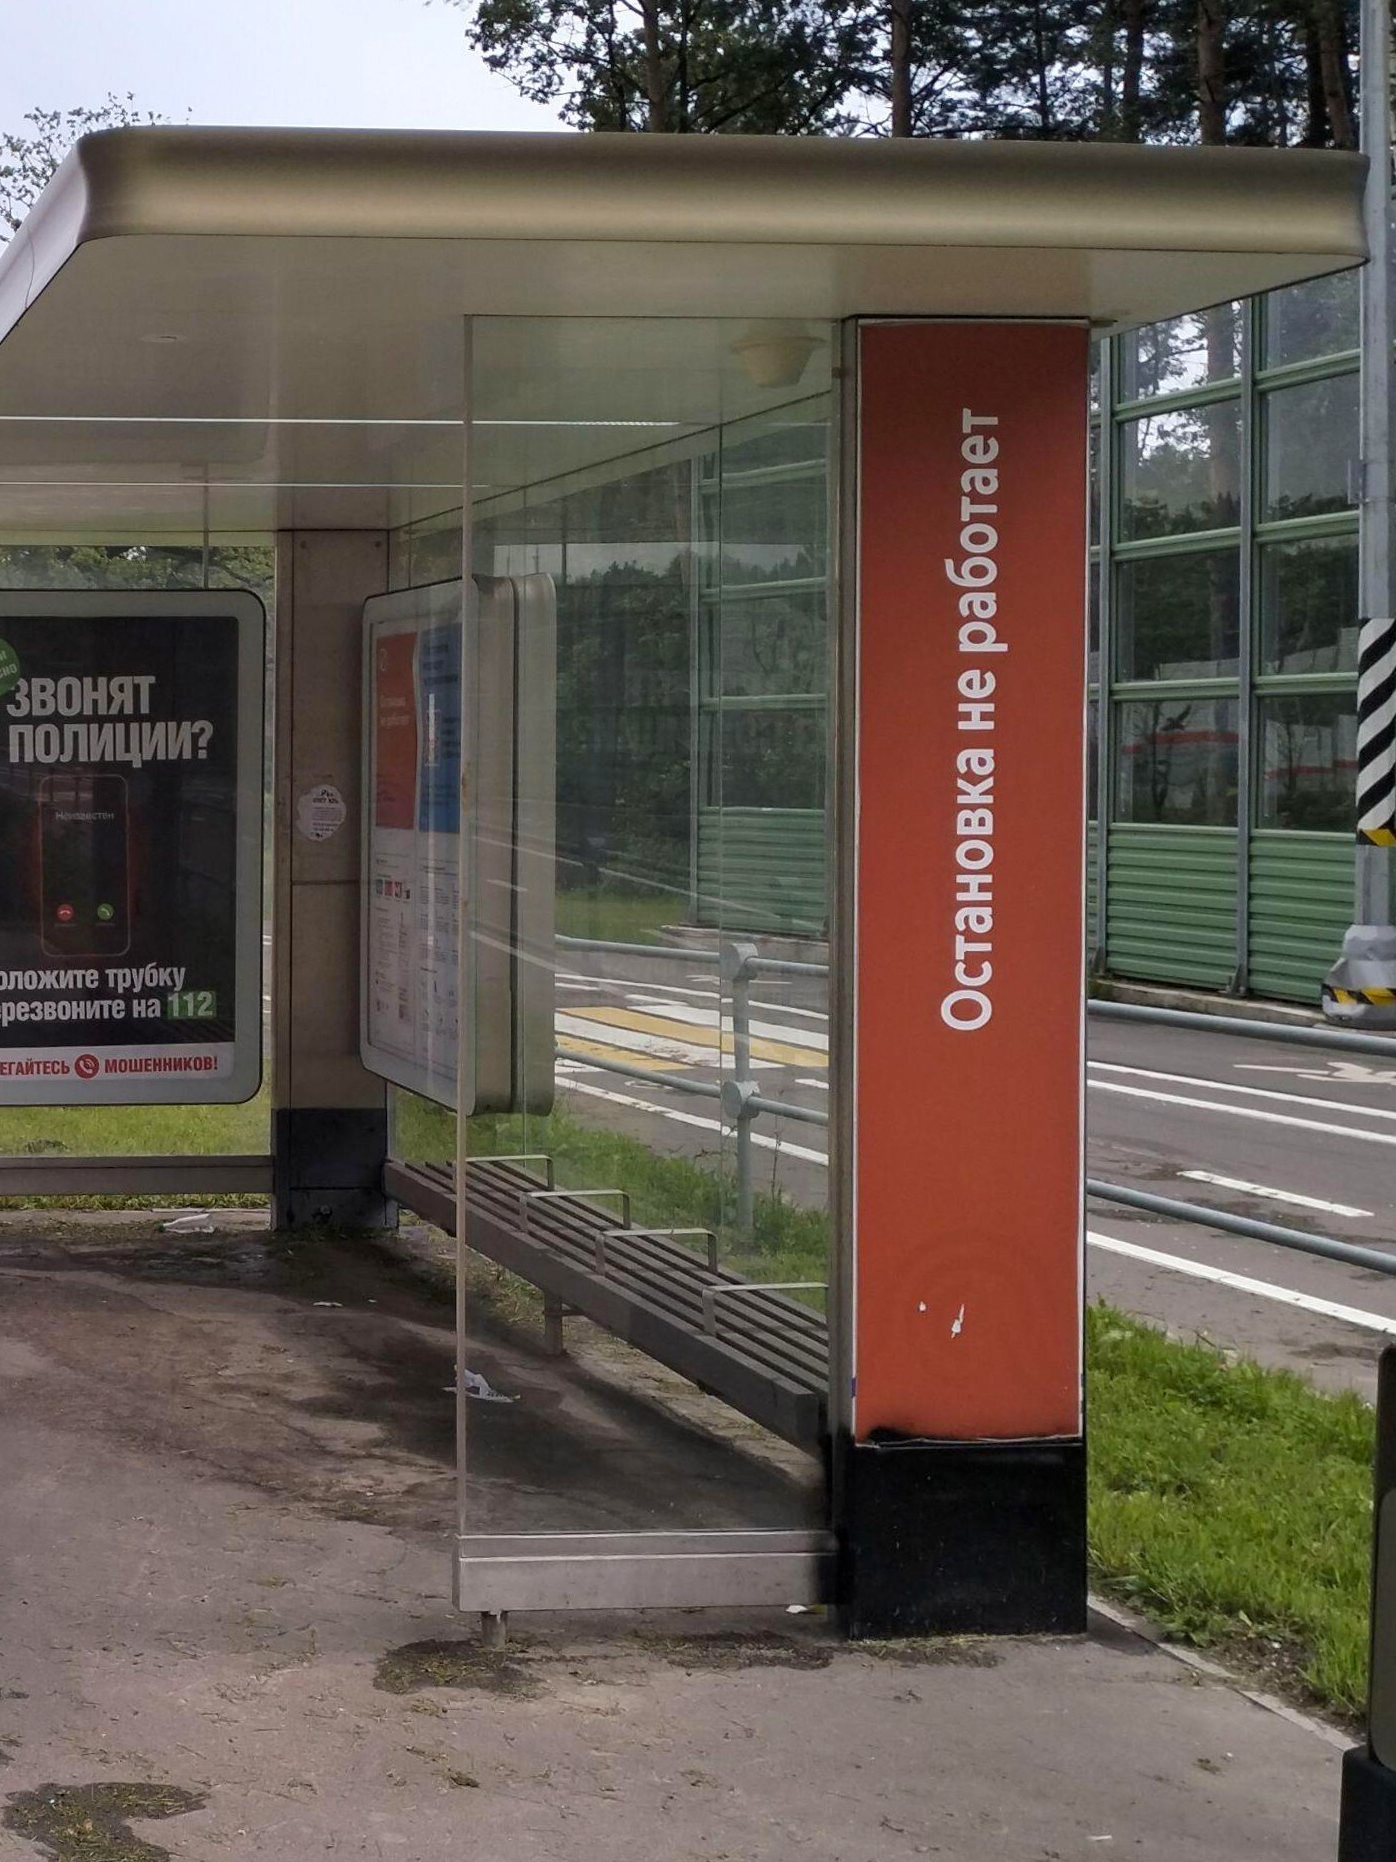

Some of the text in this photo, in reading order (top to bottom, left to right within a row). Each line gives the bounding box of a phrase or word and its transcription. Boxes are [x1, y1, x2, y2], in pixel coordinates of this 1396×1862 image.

[6, 675, 156, 717] ЗВОНЯТ
[941, 407, 1008, 1031] Остановка не работает
[8, 720, 214, 768] ПОЛИЦИИ?
[105, 962, 187, 993] трубку
[133, 998, 161, 1019] на
[168, 991, 213, 1017] 112
[105, 1056, 218, 1074] МОШЕННИКОВ!
